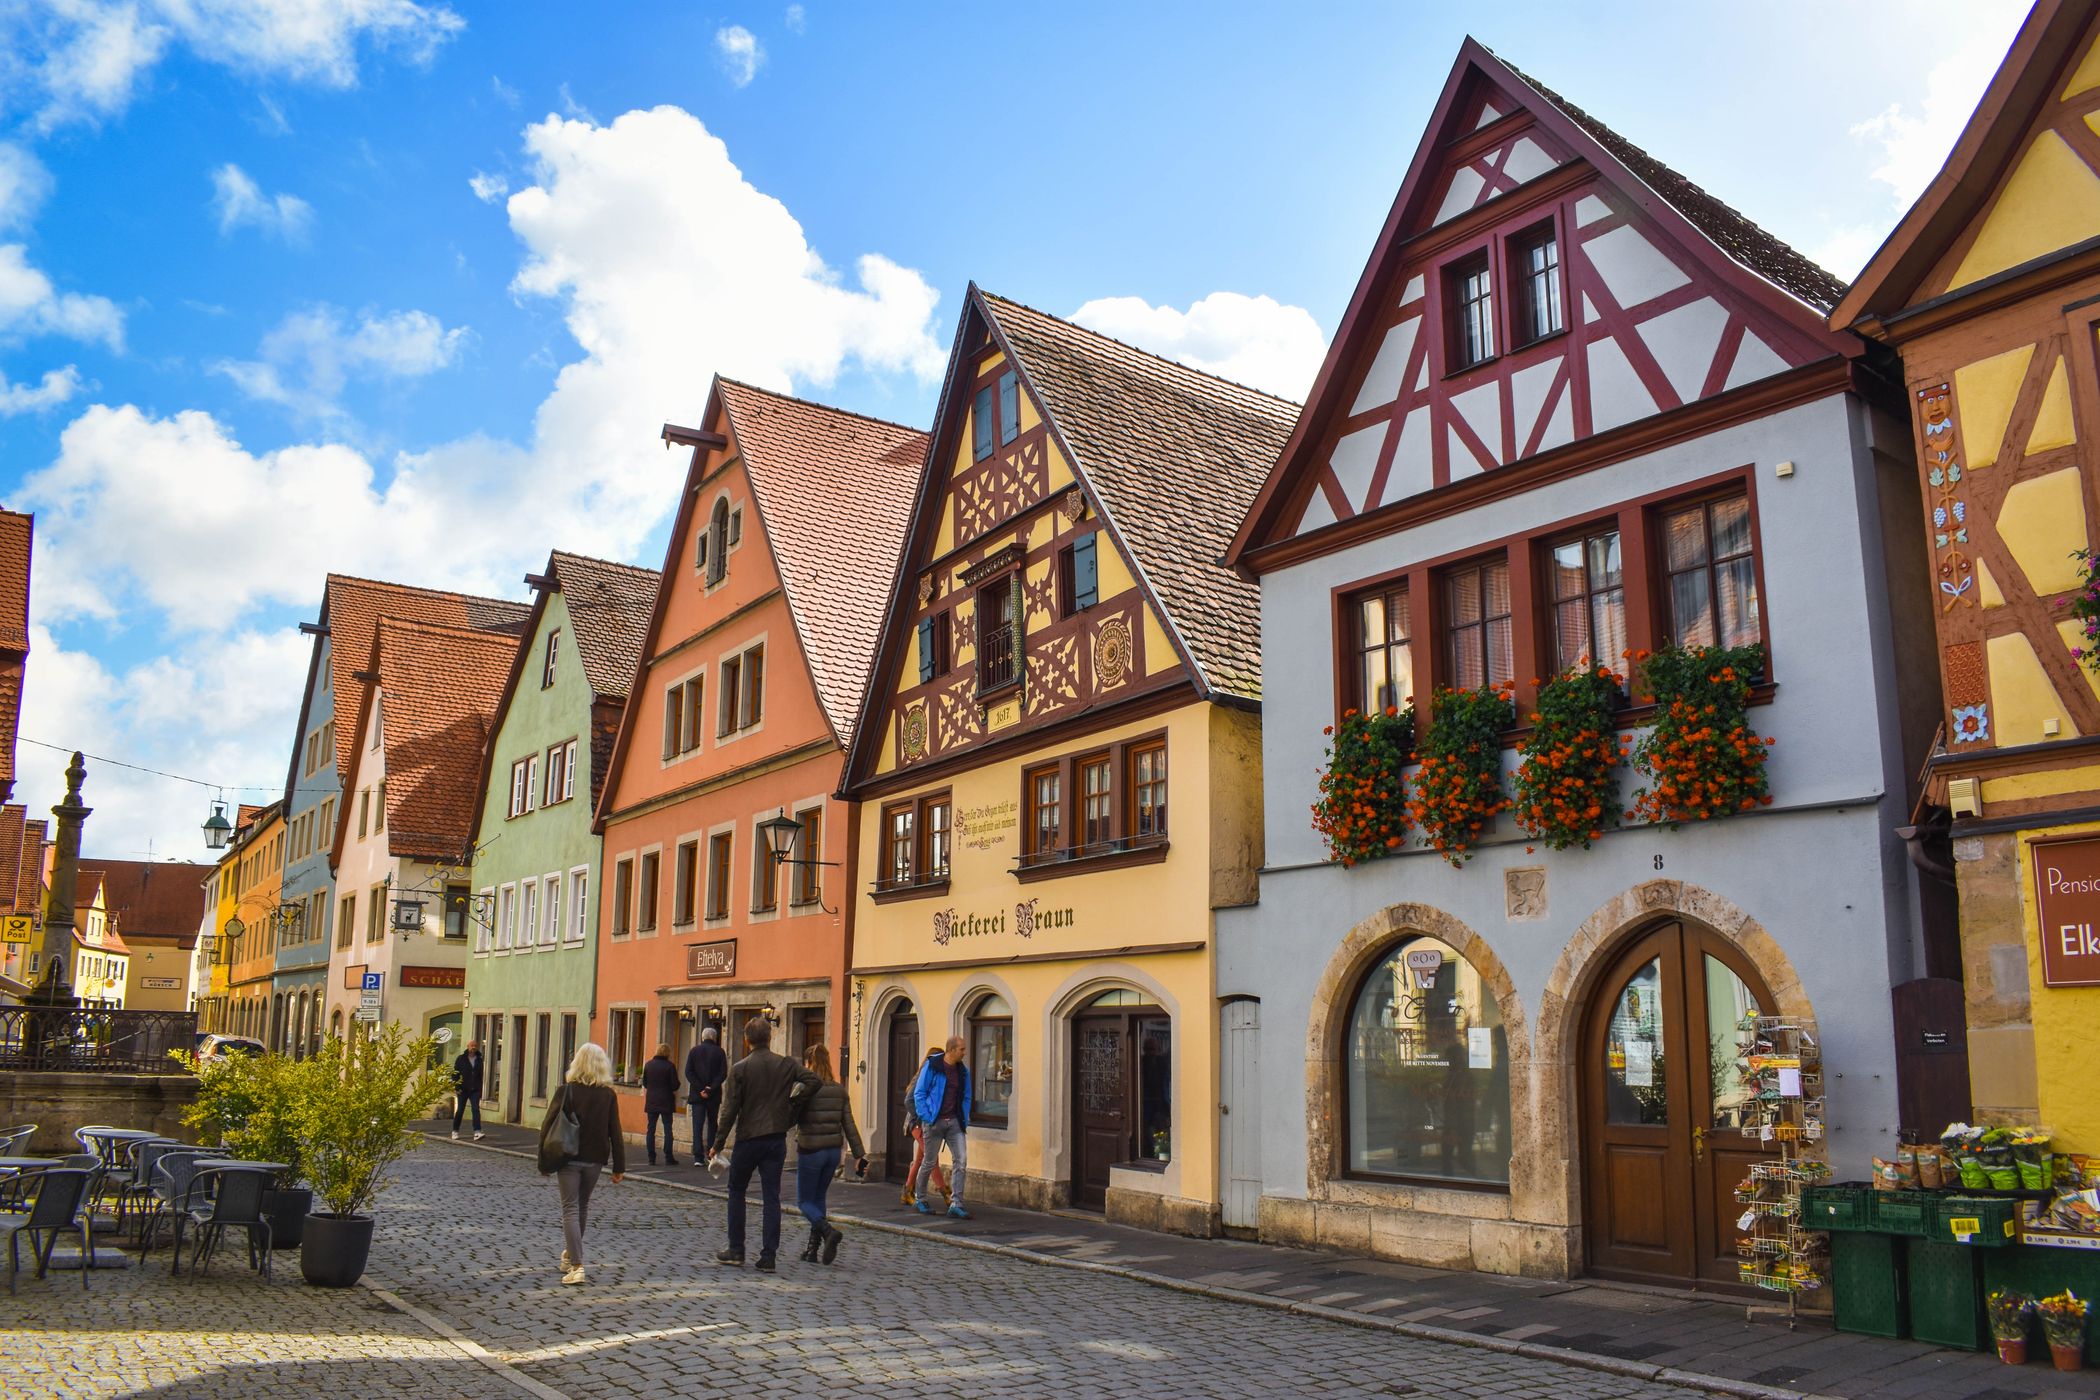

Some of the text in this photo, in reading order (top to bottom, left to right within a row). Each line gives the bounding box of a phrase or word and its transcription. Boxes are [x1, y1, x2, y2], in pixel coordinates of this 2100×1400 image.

[1653, 854, 1664, 870] 8
[933, 897, 1074, 946] Bäckerei Braun
[7, 930, 26, 938] Post
[2060, 923, 2100, 956] Elk
[366, 975, 377, 989] P
